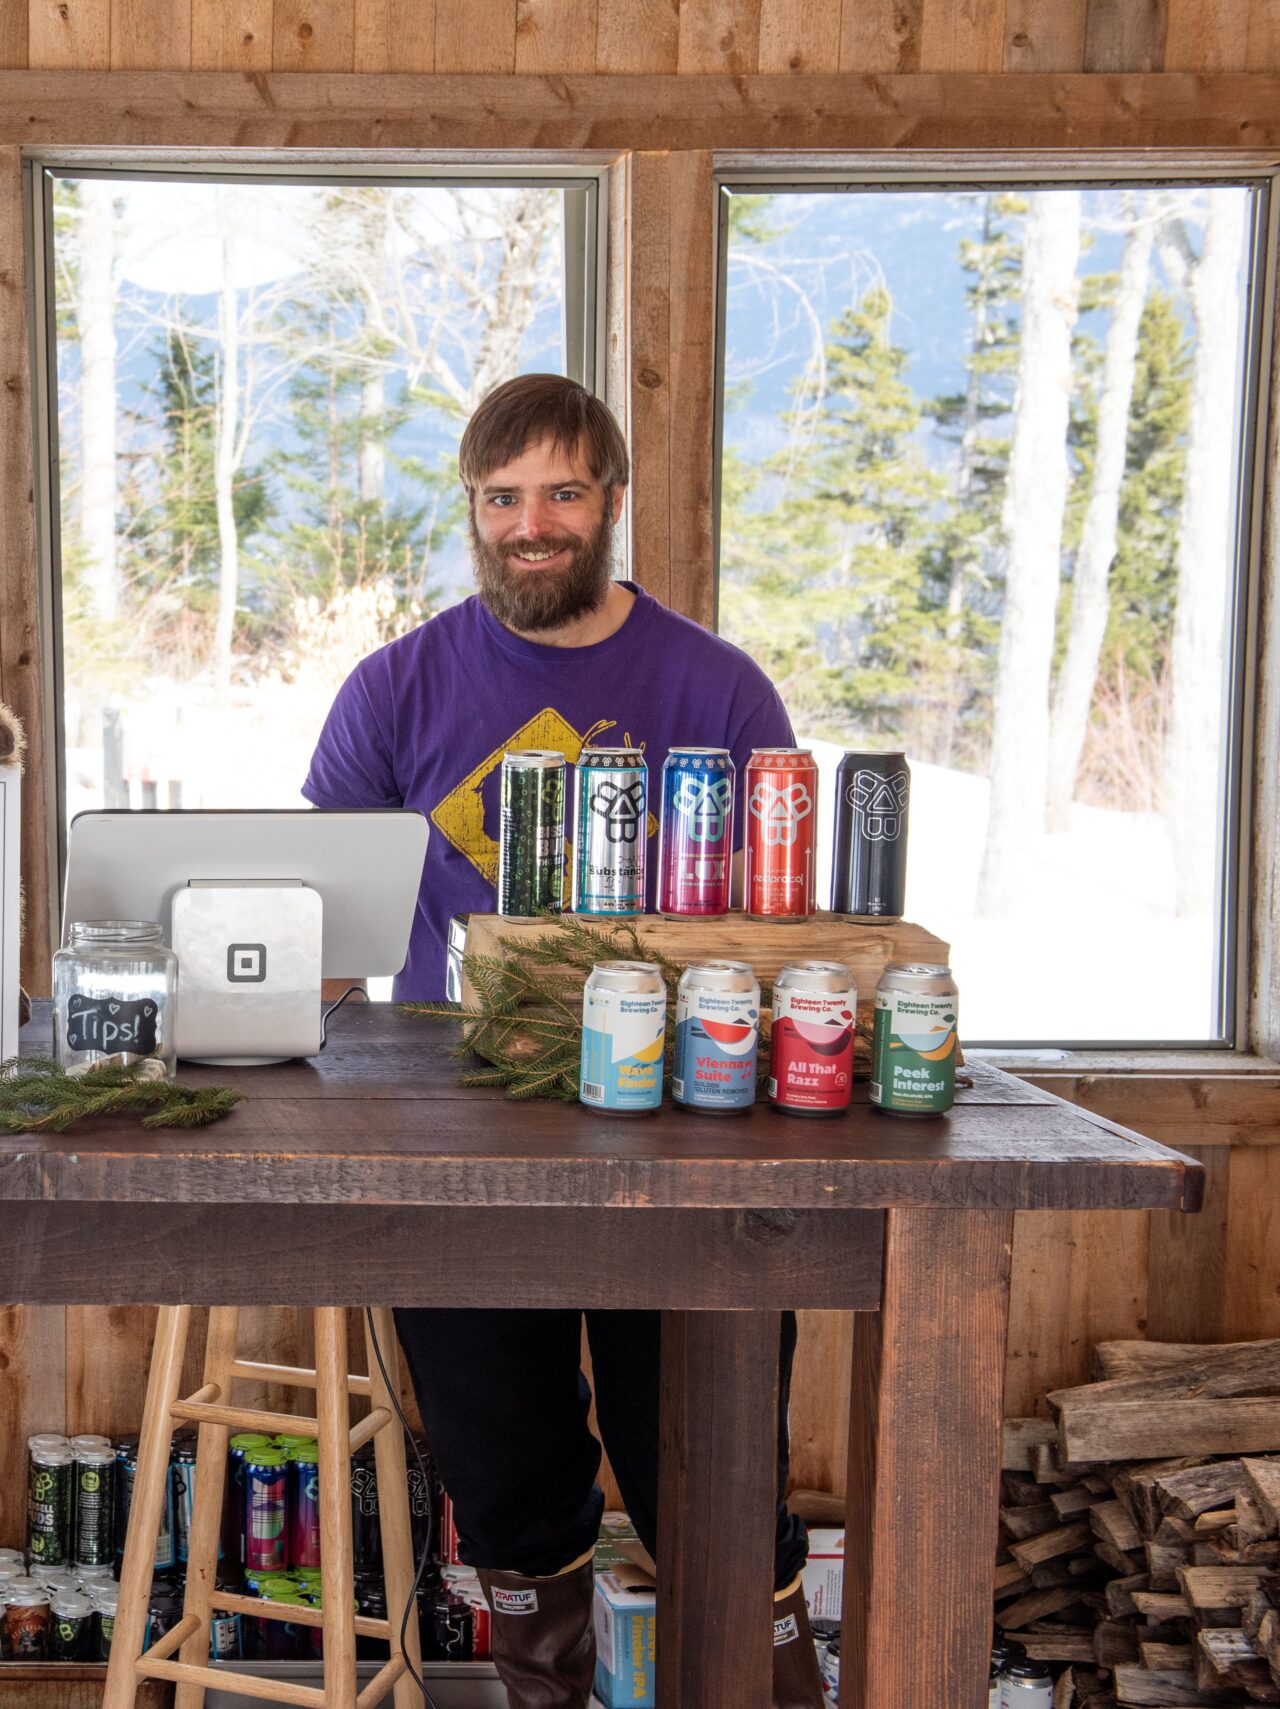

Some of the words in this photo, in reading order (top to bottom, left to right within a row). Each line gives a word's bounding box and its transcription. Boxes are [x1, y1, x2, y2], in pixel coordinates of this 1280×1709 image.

[539, 824, 562, 838] BISS
[539, 839, 562, 856] BU
[679, 860, 724, 880] LUX
[620, 1000, 651, 1008] Eighteen
[699, 996, 731, 1006] Eighteen
[731, 998, 753, 1007] Twenty
[790, 996, 822, 1006] Eighteen
[823, 997, 846, 1007] Twenty
[897, 1000, 929, 1010] Eighteen
[930, 1002, 952, 1010] Twenty
[620, 1007, 650, 1015] Brewing
[698, 1004, 729, 1013] Brewing
[790, 1004, 822, 1014] Brewing
[897, 1007, 928, 1016] Brewing
[71, 1008, 140, 1050] Tips!
[696, 1056, 744, 1069] Vienna
[788, 1061, 807, 1074] All
[808, 1063, 837, 1075] That
[618, 1065, 655, 1075] Wave
[695, 1069, 732, 1082] Suite
[894, 1065, 931, 1079] Peek
[617, 1078, 658, 1089] Finder
[693, 1080, 720, 1088] GOLDEN
[787, 1073, 820, 1087] Razz
[893, 1078, 945, 1092] Interest
[722, 1087, 749, 1095] REMOVED
[30, 1512, 54, 1526] UDS
[495, 1590, 532, 1602] XTRATUF
[632, 1615, 644, 1669] Finder
[633, 1671, 646, 1699] IPA
